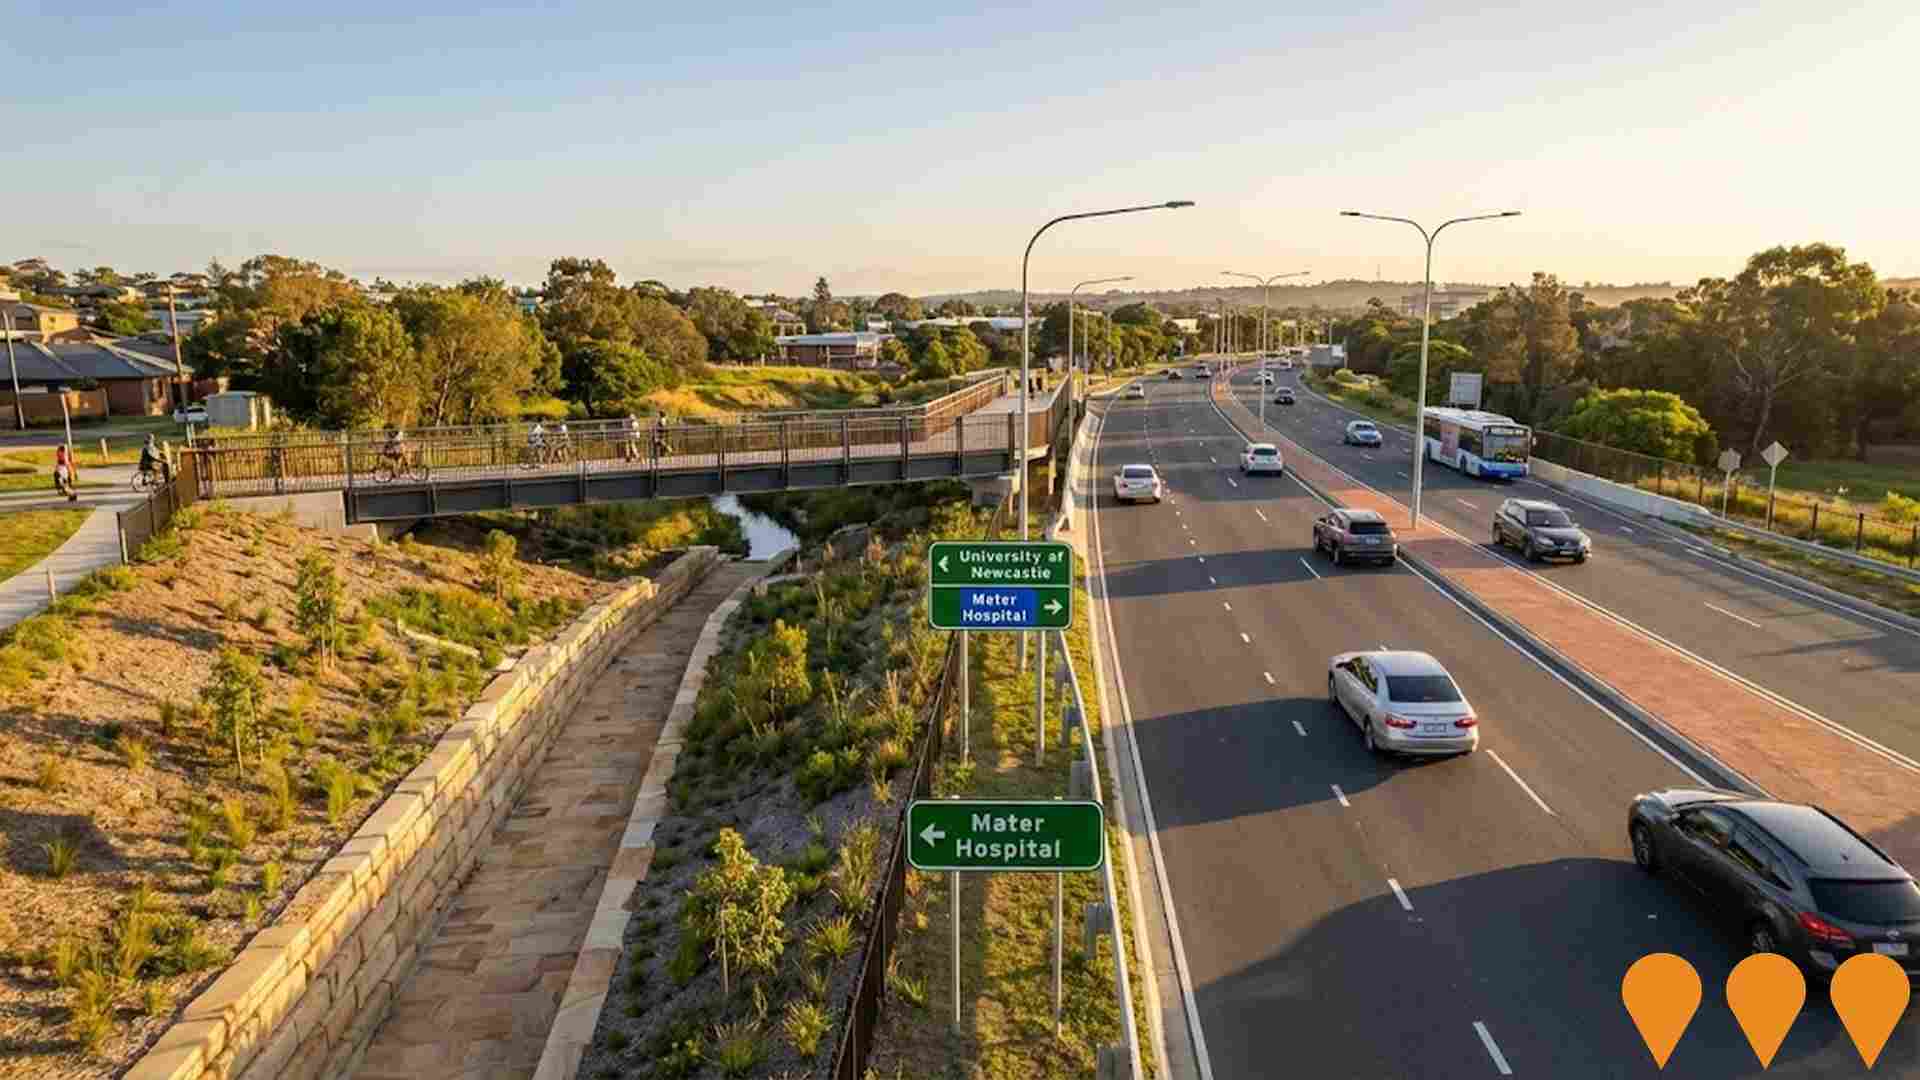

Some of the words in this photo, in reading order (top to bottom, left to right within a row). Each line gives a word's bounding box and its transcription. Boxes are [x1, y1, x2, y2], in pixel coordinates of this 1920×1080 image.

[959, 550, 1042, 565] University
[962, 609, 1027, 623] Hospital
[971, 813, 1045, 832] Mater
[955, 838, 1061, 863] Hospital
